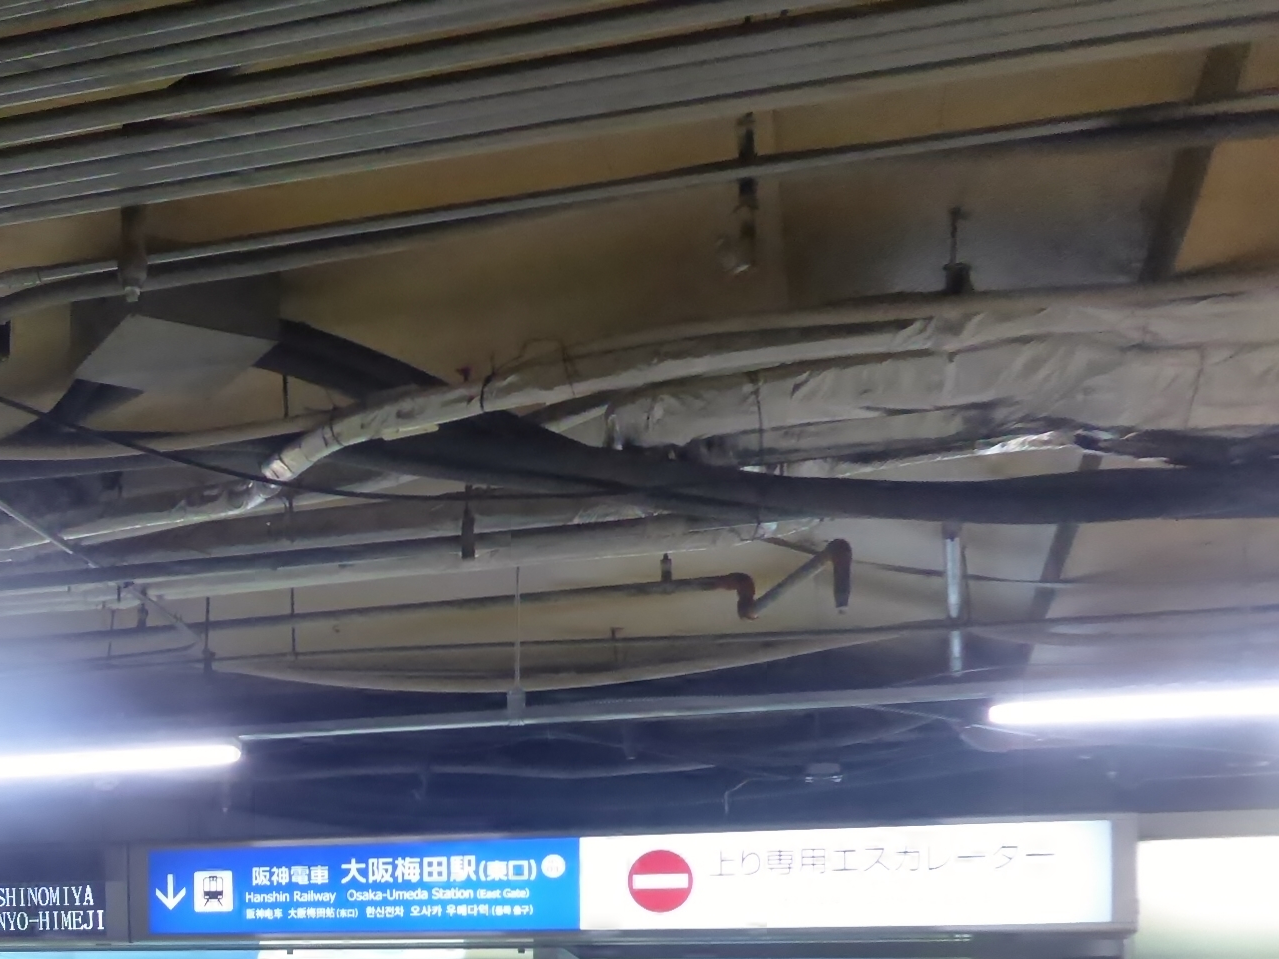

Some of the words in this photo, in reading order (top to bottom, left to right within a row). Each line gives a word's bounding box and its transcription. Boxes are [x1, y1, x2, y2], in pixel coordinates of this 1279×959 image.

[251, 865, 329, 886] 阪神電車
[340, 854, 537, 884] 大阪梅田駅(東口)
[709, 845, 1056, 877] 上り専用エスカレーター
[245, 891, 290, 903] Hanshin
[293, 889, 337, 903] Railway
[346, 888, 428, 901] Osaka-Umeda
[431, 886, 474, 900] Station
[410, 904, 443, 917] 오사카
